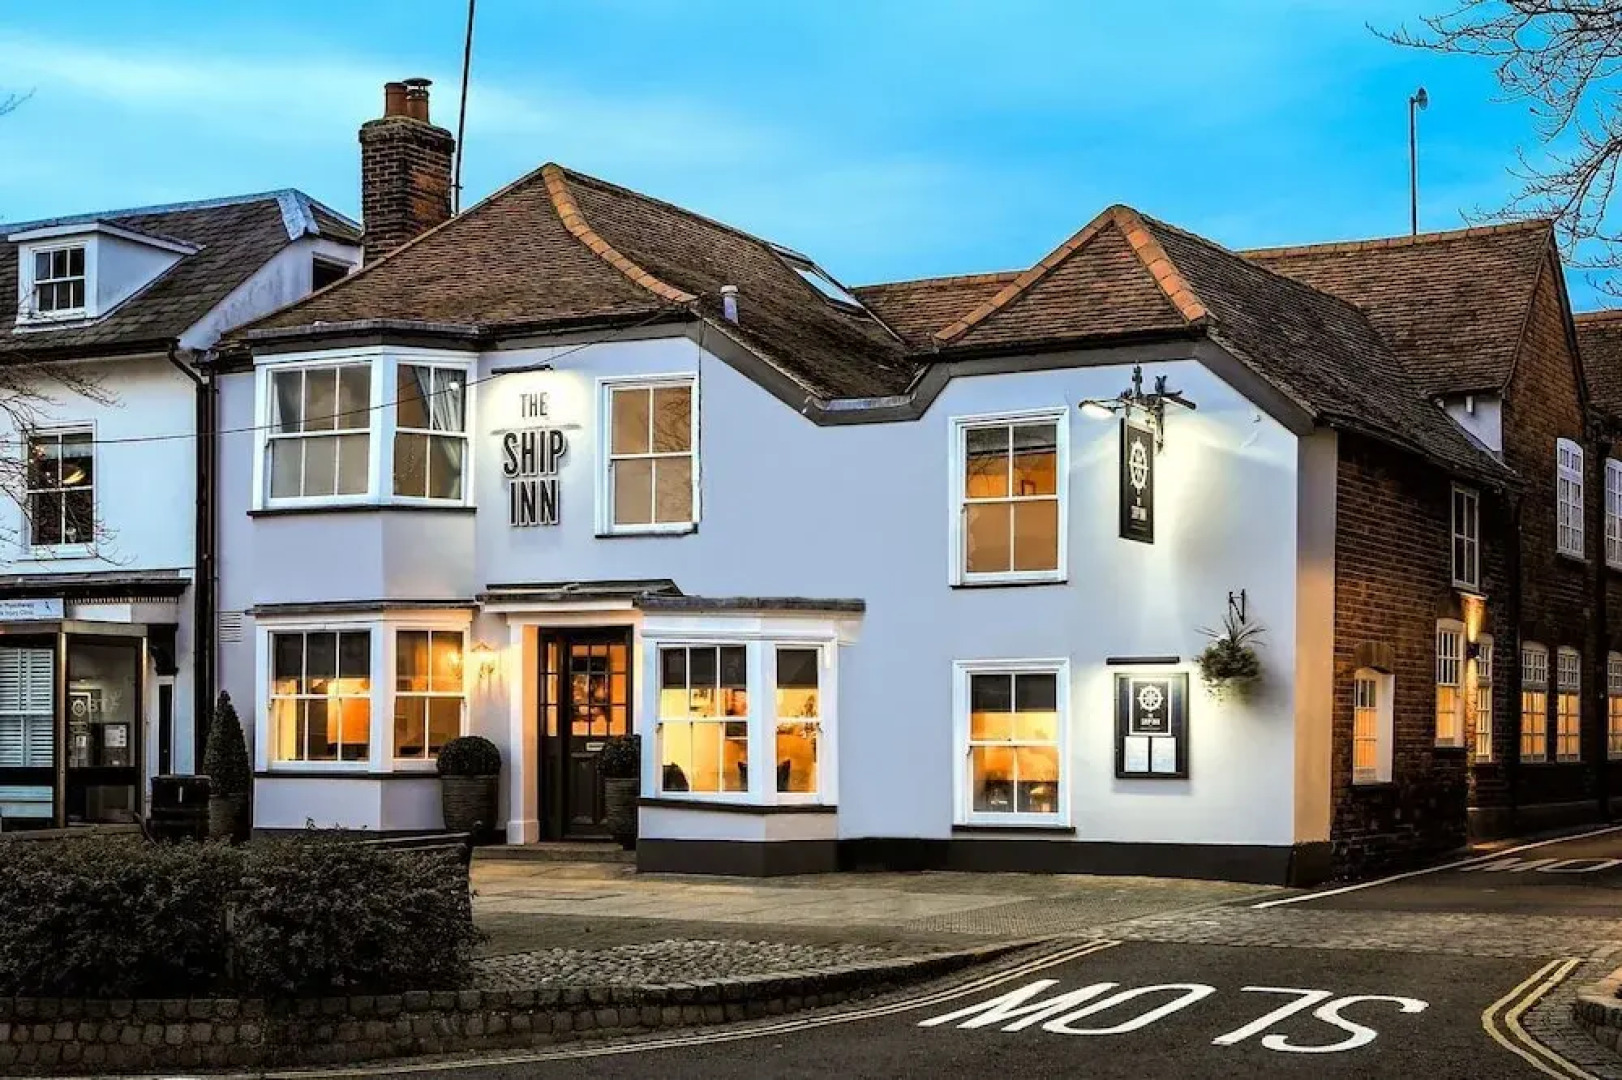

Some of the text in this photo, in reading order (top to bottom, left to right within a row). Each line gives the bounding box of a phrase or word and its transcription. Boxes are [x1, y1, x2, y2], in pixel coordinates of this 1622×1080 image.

[519, 391, 548, 418] THE
[503, 429, 566, 477] SHIP
[509, 479, 560, 526] INN
[917, 978, 1430, 1053] SLOW
